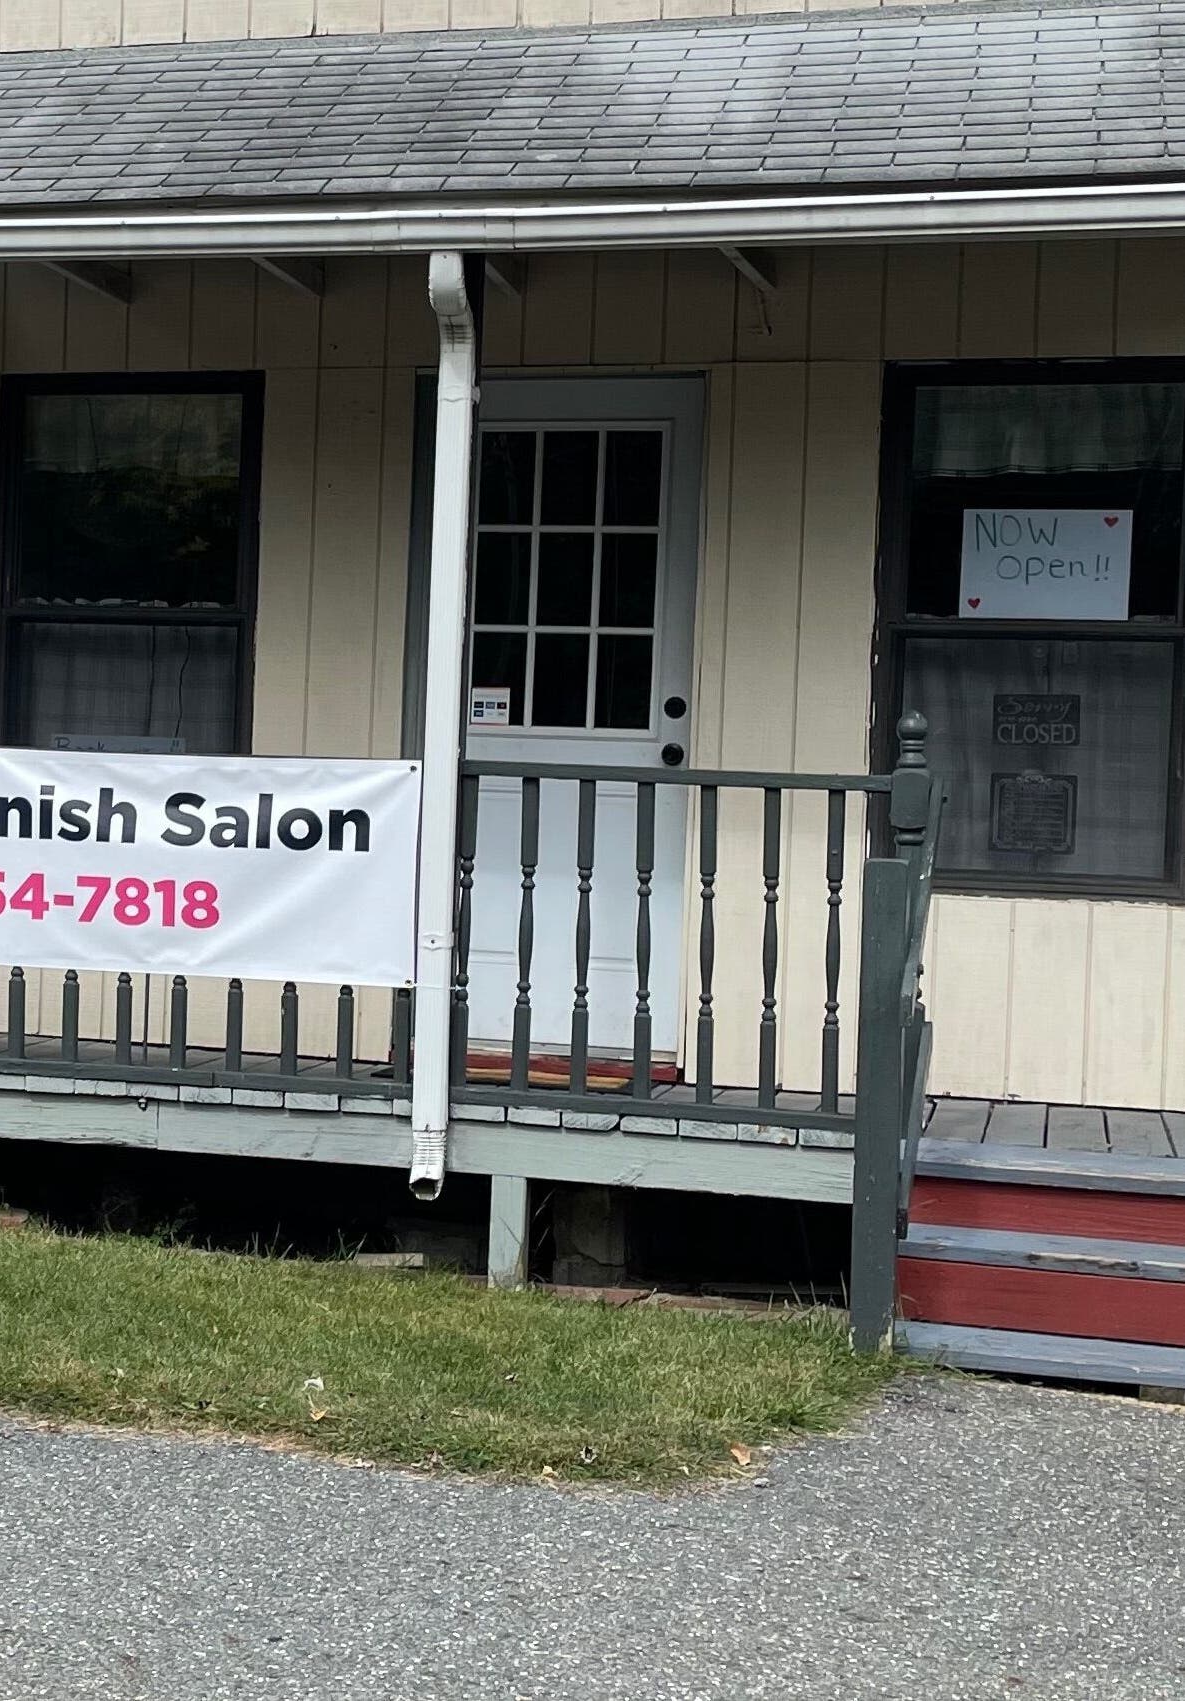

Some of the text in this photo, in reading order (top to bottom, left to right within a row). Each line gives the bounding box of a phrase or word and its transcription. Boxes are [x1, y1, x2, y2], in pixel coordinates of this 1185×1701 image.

[975, 512, 1058, 552] NOW
[997, 723, 1076, 744] CLOSED
[161, 791, 371, 853] Salon
